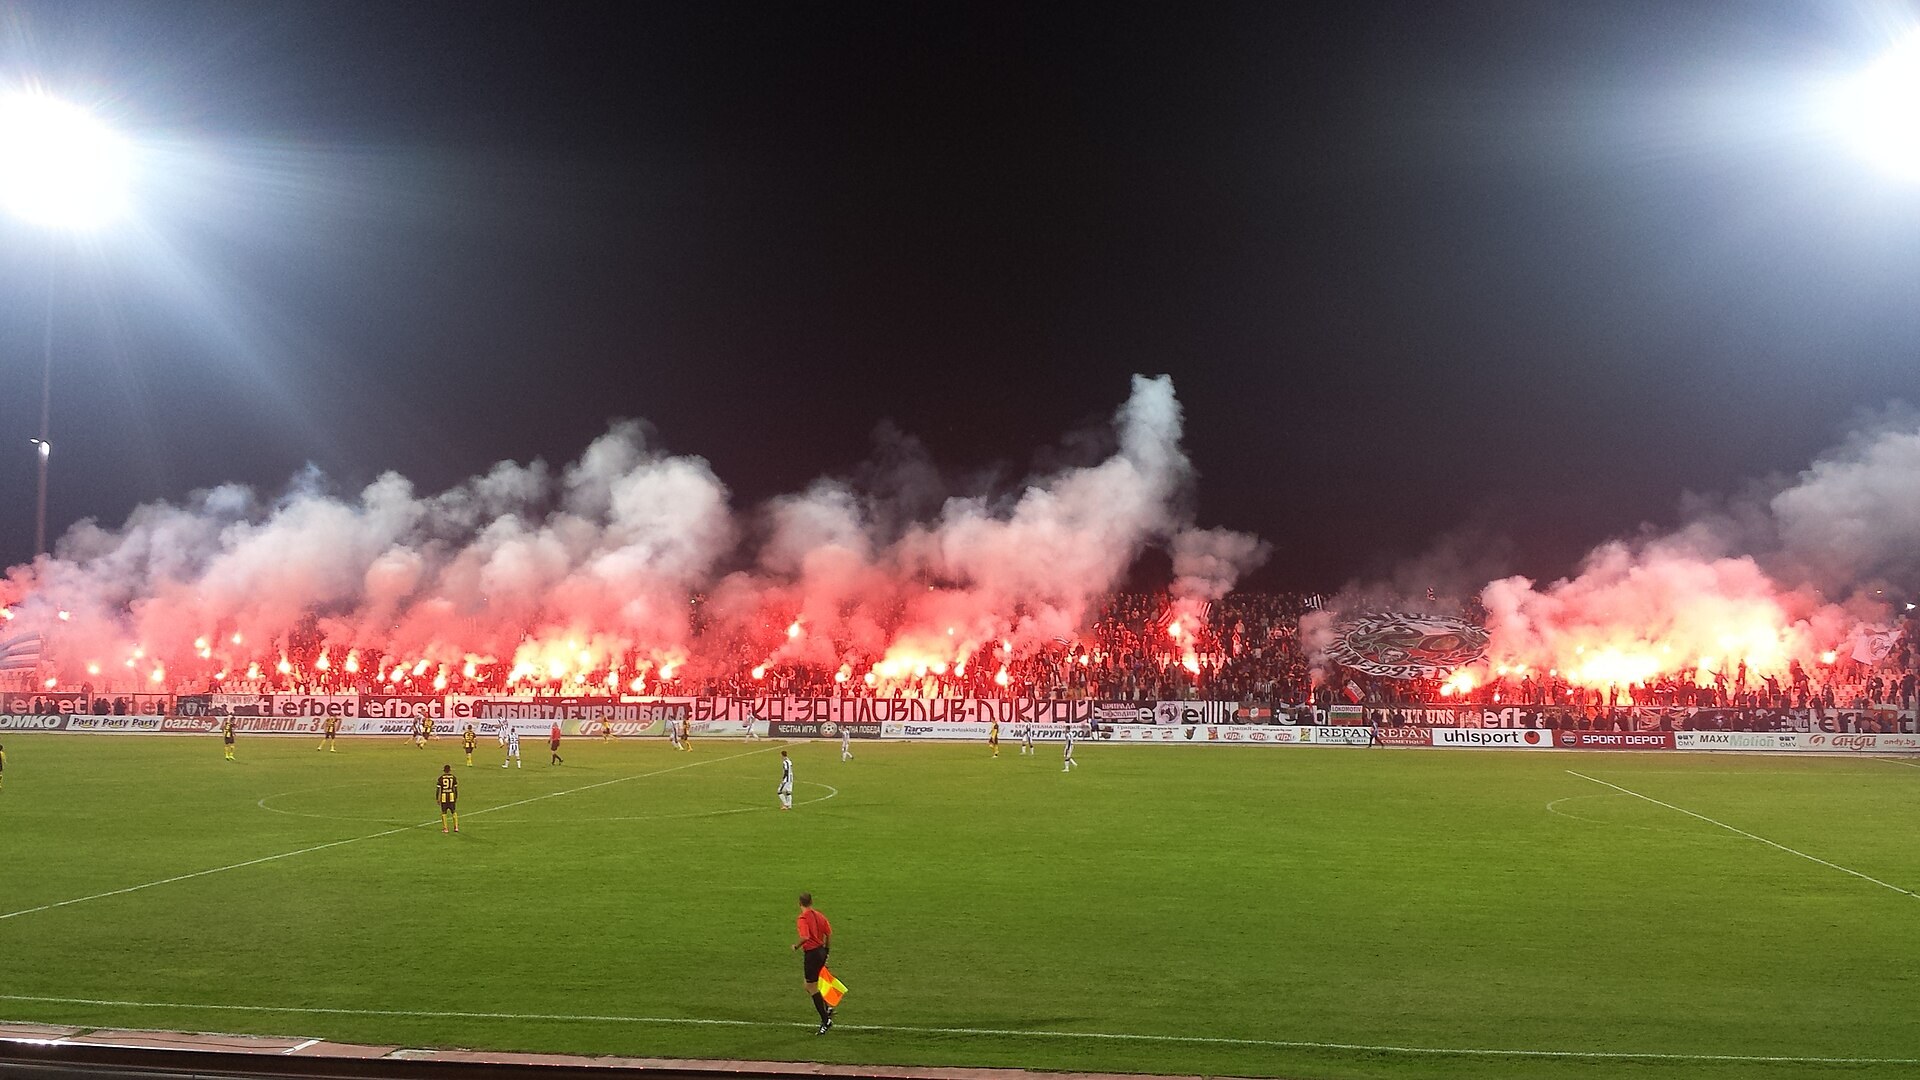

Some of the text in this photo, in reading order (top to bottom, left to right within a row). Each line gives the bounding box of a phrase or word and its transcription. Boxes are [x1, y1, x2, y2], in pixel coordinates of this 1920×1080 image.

[282, 698, 354, 717] efbet
[1426, 709, 1455, 724] UNS
[72, 718, 159, 728] Party Party Party
[164, 716, 213, 731] oazis.bg
[778, 725, 817, 733] ЧЕСТНА ИГРА
[858, 725, 881, 734] ПОБЕДА
[904, 725, 933, 733] Taros
[1377, 728, 1430, 738] REFAN
[1444, 730, 1518, 745] uhlsport
[1582, 735, 1623, 744] SPORT
[1625, 735, 1666, 745] DEPOT
[1729, 735, 1775, 747] Motion
[1883, 739, 1916, 747] andy.bg
[442, 778, 454, 789] 91
